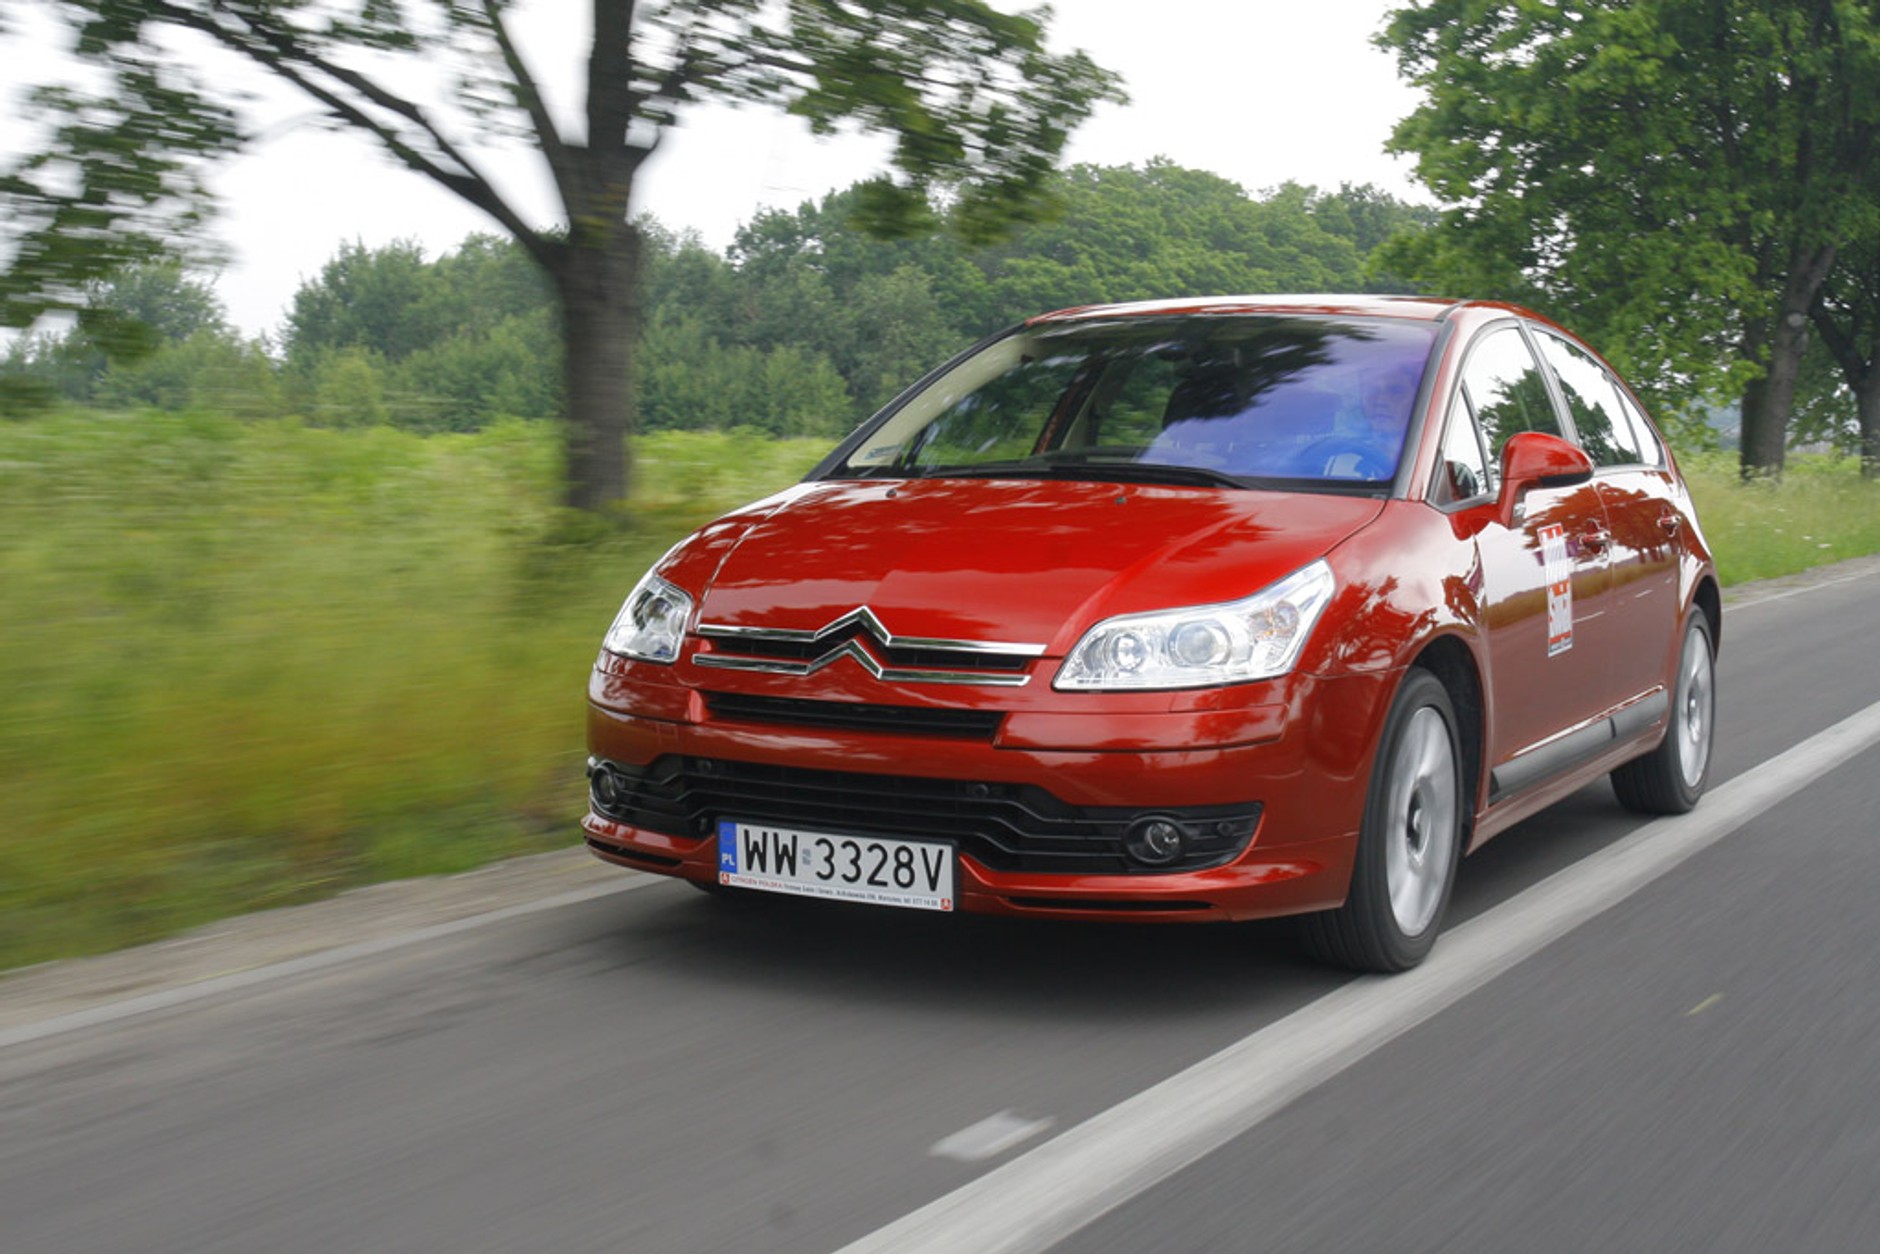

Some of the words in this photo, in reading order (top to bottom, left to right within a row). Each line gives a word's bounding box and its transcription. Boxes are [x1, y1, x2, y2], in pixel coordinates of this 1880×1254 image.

[721, 852, 735, 867] PL
[743, 828, 798, 877] WW
[814, 837, 945, 892] 3328V
